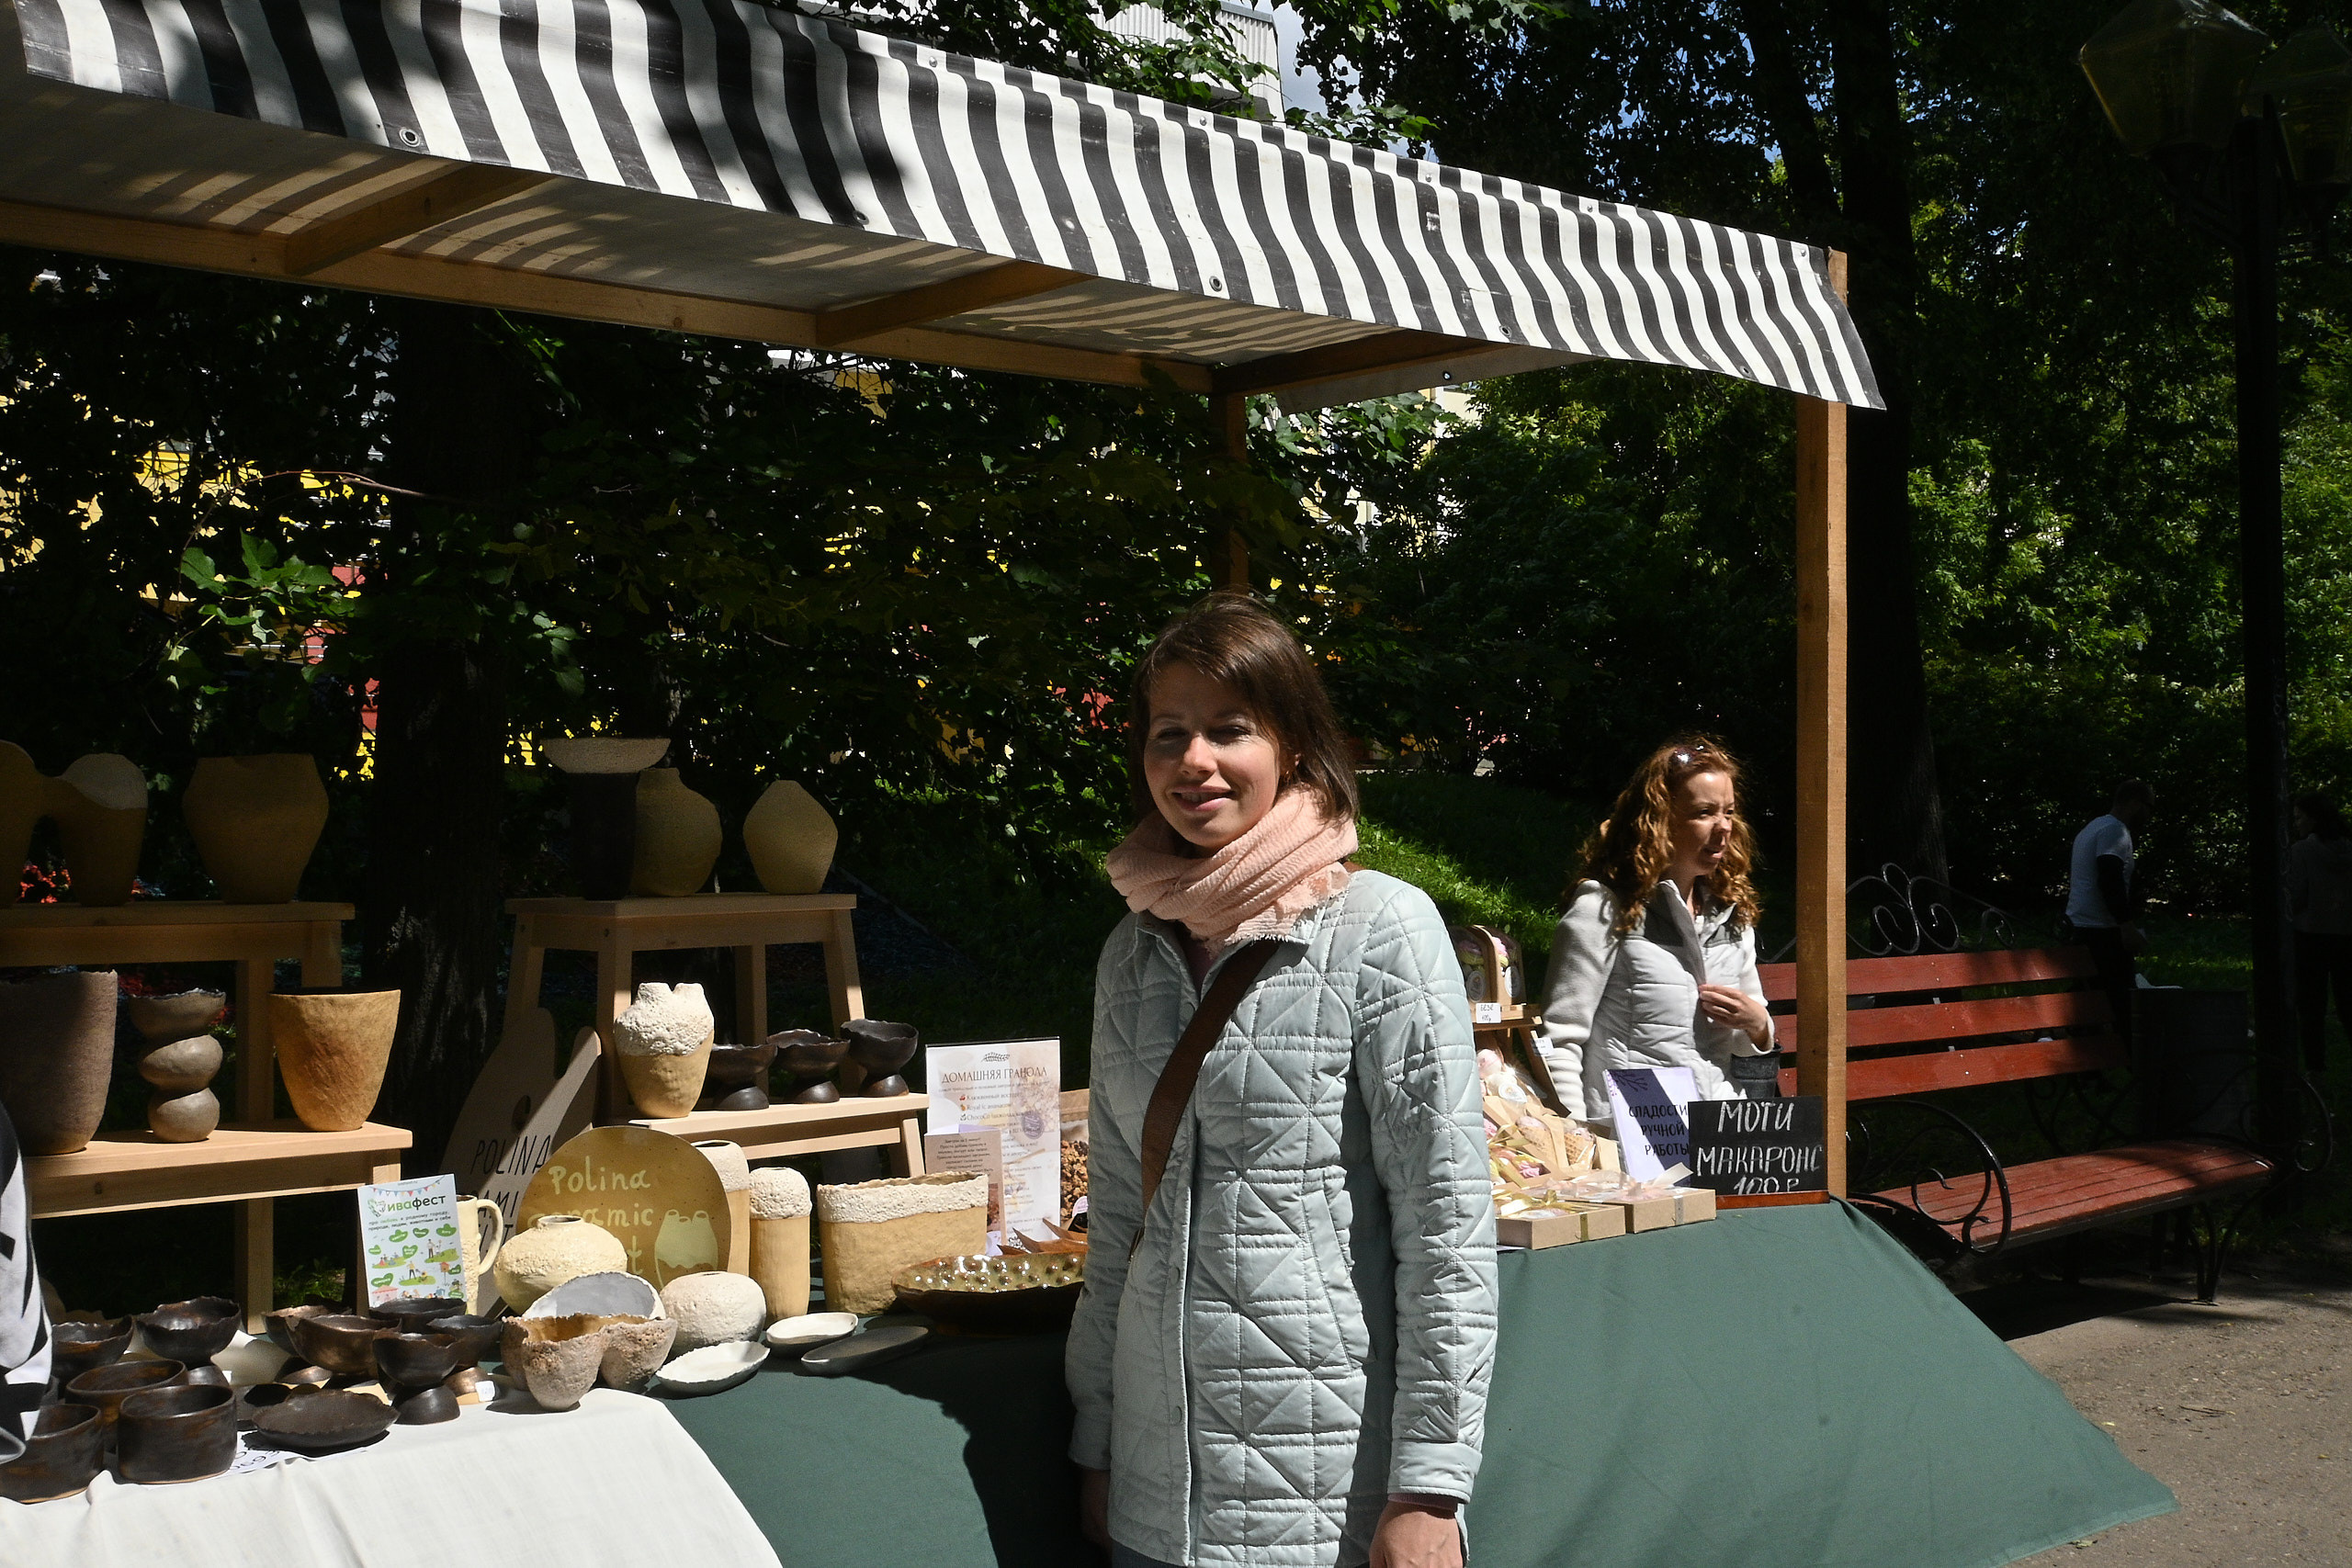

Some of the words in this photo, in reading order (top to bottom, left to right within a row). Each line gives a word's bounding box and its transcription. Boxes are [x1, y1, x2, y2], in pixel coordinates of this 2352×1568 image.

[941, 1069, 1001, 1084] ДОМАШНЯЯ
[1003, 1066, 1048, 1079] ГРАНОЛА
[1628, 1104, 1688, 1120] СЛАДОСТИ
[1717, 1100, 1794, 1133] МОТИ
[1640, 1122, 1685, 1137] РУЧНОЙ
[469, 1134, 551, 1176] POLINA
[1645, 1143, 1690, 1157] РАБОТЫ
[1696, 1144, 1824, 1177] МАКАРОНС
[548, 1155, 651, 1195] Polina
[387, 1195, 447, 1213] ивафест
